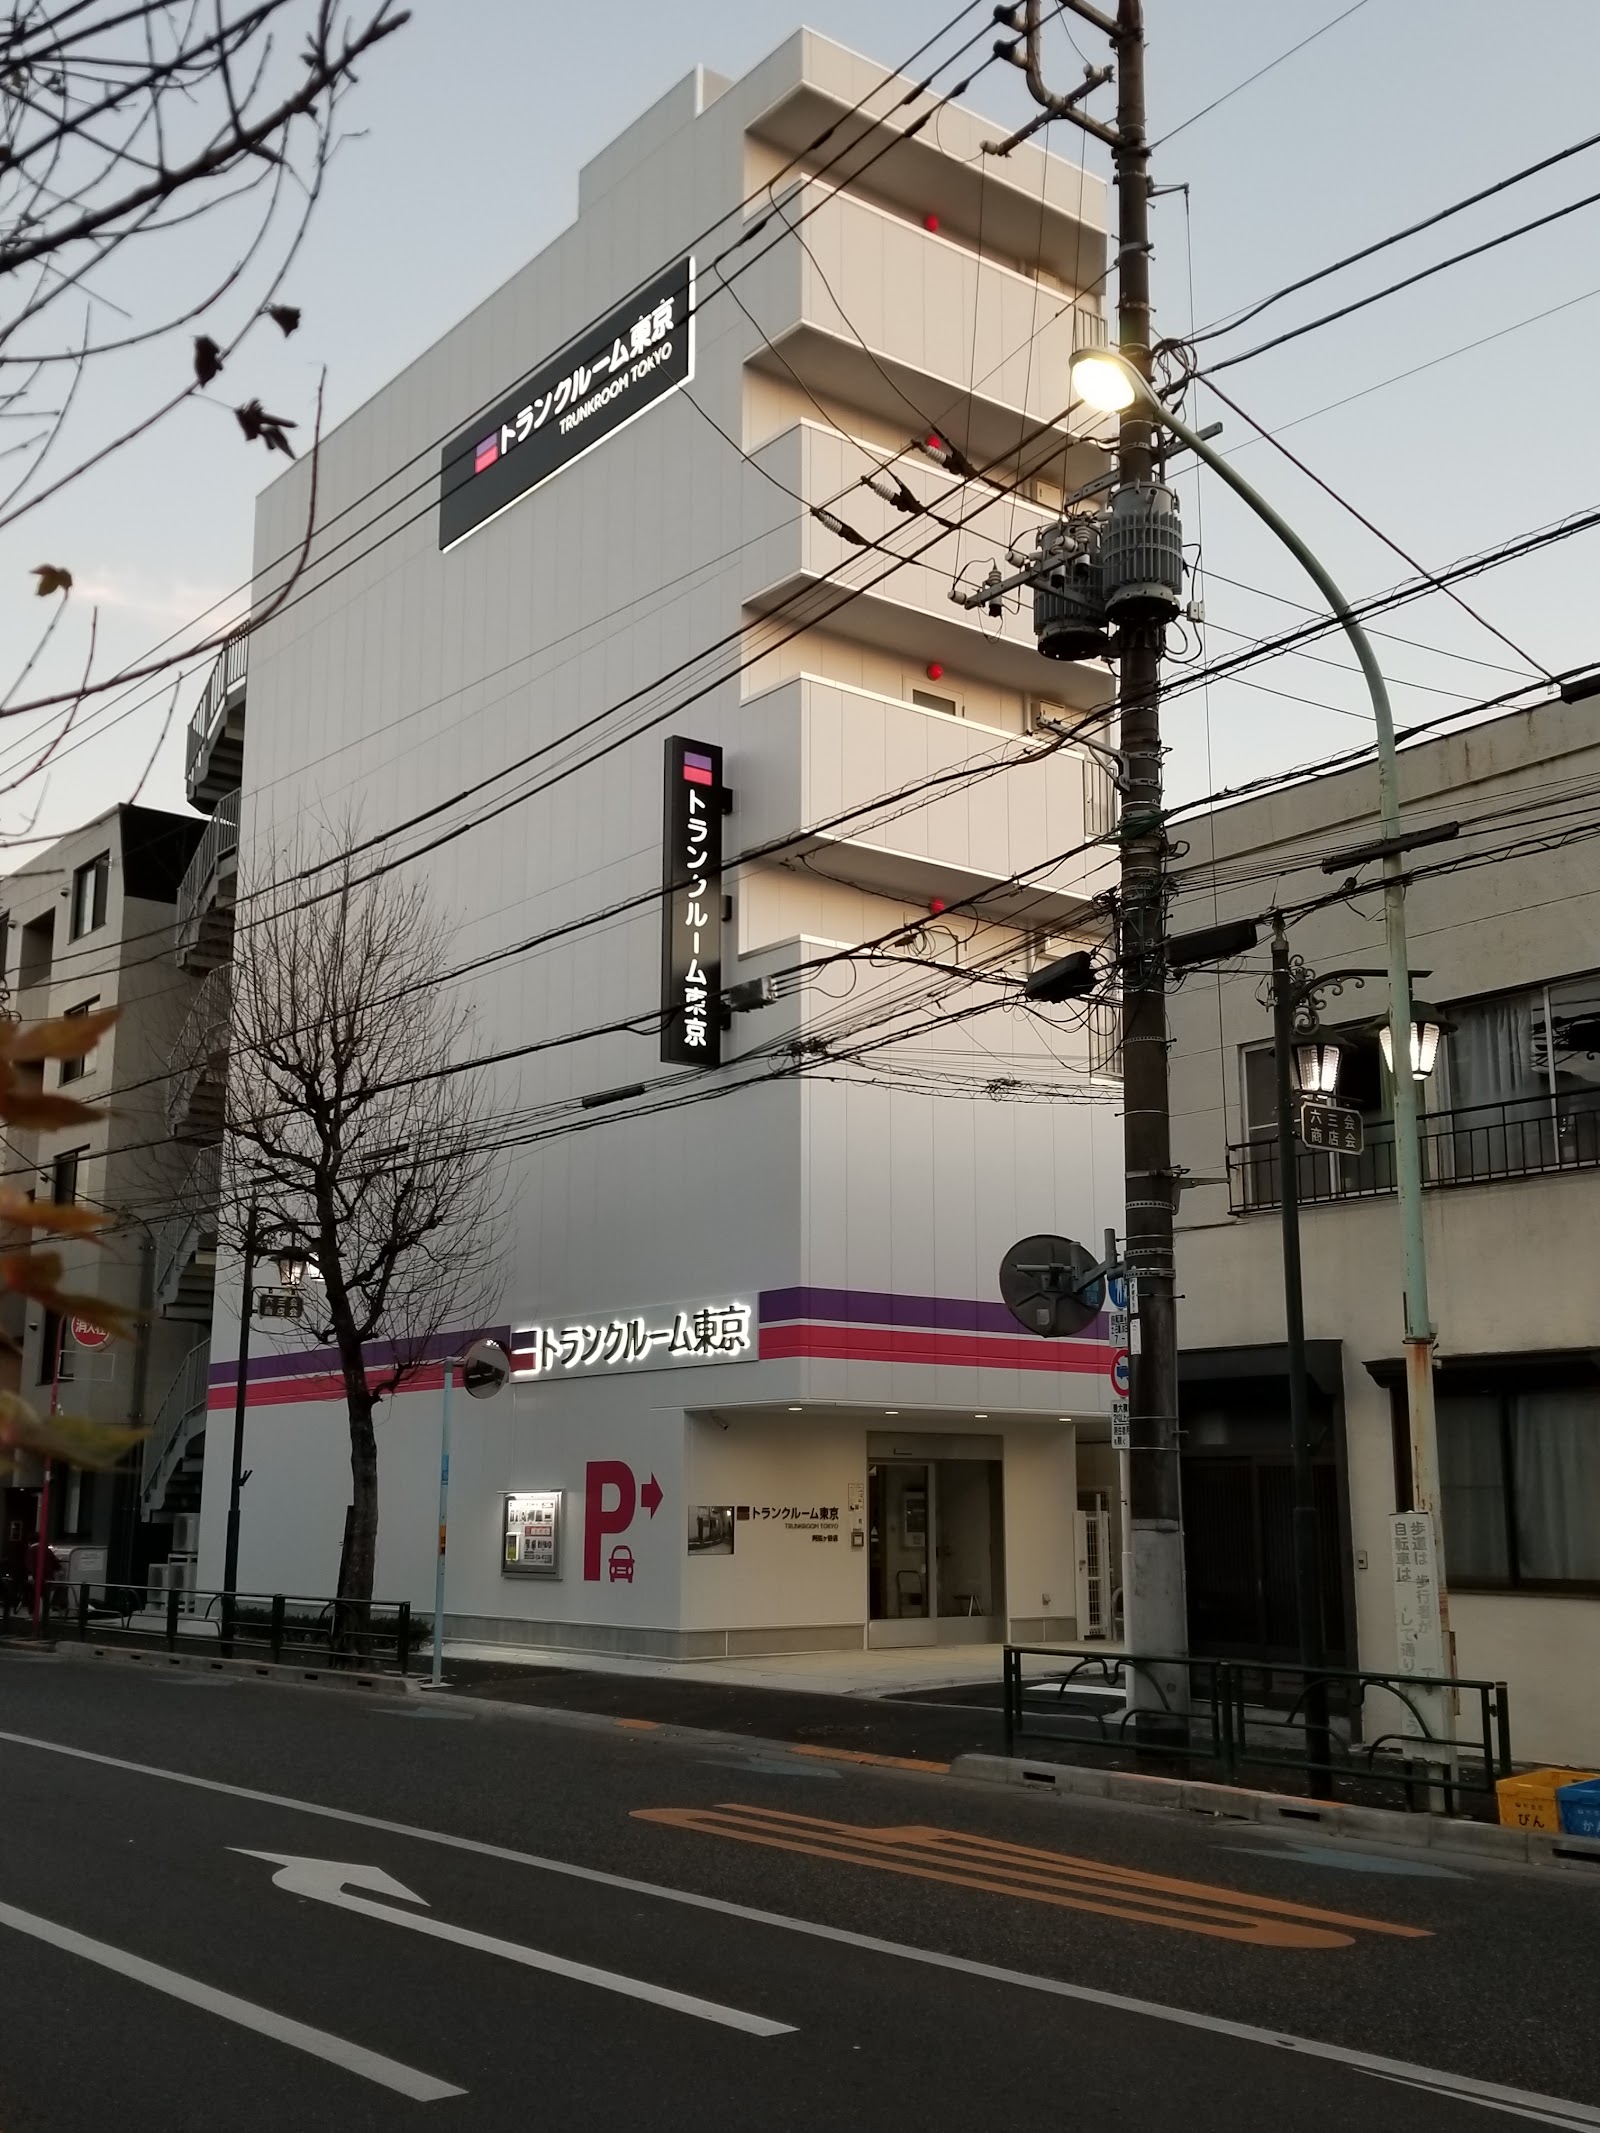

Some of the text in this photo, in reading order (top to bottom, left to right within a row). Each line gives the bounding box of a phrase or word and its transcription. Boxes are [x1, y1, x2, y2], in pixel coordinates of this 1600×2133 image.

[500, 296, 675, 455] トランクルーム東京
[558, 341, 674, 435] TRUNKROOM TOKYO
[683, 788, 709, 1048] トランクルーム東京
[1310, 1109, 1355, 1130] 六三会
[1310, 1127, 1356, 1148] 商店会
[541, 1305, 746, 1367] トランクルーム東京
[584, 1461, 636, 1582] P
[752, 1506, 839, 1521] トランクルーム東京
[1518, 1813, 1545, 1829] びん
